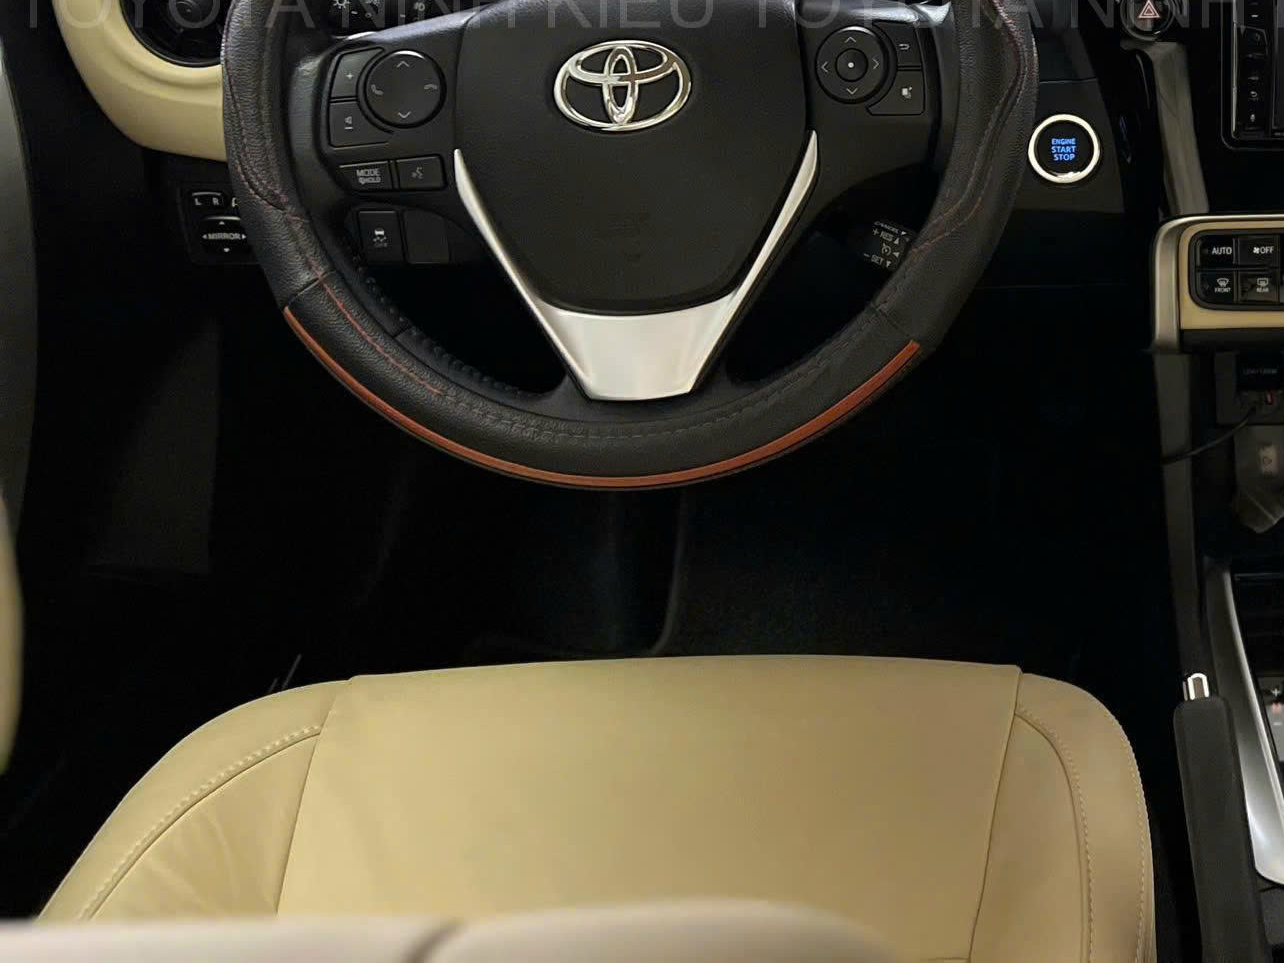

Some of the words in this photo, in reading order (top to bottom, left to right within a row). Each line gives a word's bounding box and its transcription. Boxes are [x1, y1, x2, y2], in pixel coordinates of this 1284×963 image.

[1053, 153, 1076, 161] STOP
[1211, 246, 1233, 255] AUTO
[1260, 245, 1275, 254] OFF
